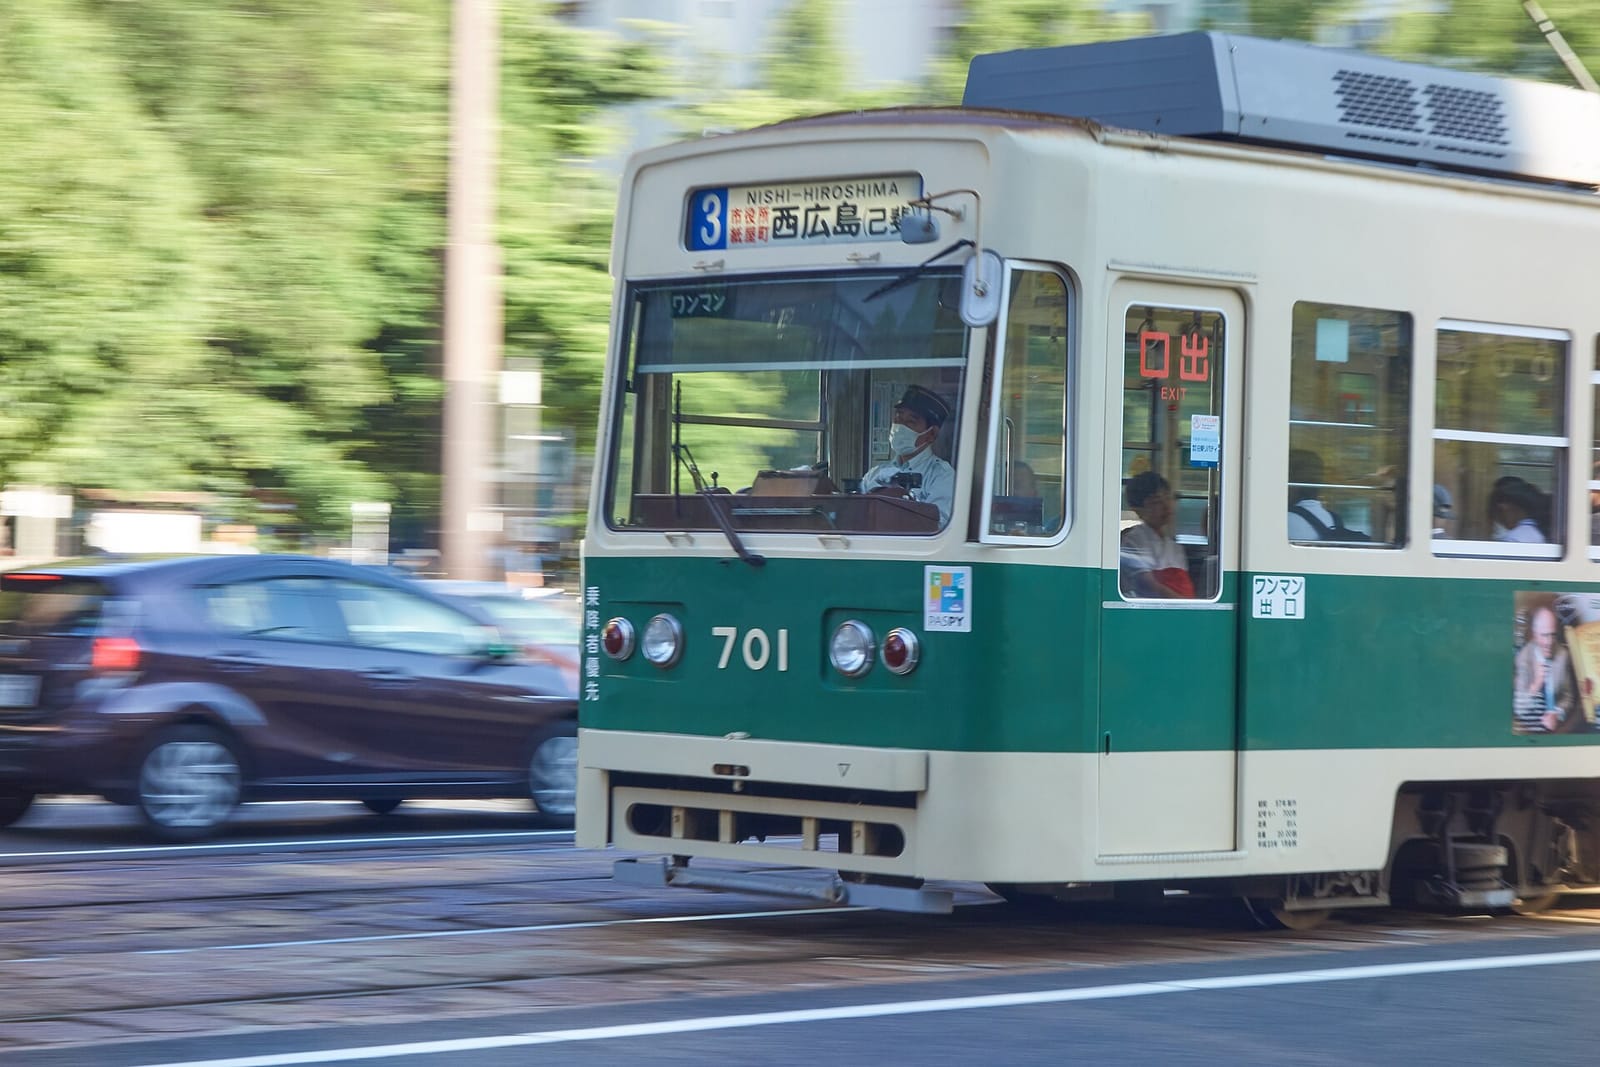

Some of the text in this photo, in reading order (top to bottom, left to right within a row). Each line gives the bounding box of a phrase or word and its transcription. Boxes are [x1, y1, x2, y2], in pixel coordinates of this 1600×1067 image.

[746, 181, 899, 204] NISHI-HIROSHIMA
[702, 193, 722, 246] 3
[672, 294, 726, 314] ワンマン
[1161, 386, 1187, 400] EXIT
[1255, 578, 1303, 595] ワンマン
[1260, 598, 1297, 616] 出口
[928, 615, 965, 627] PASPY
[711, 626, 788, 671] 701
